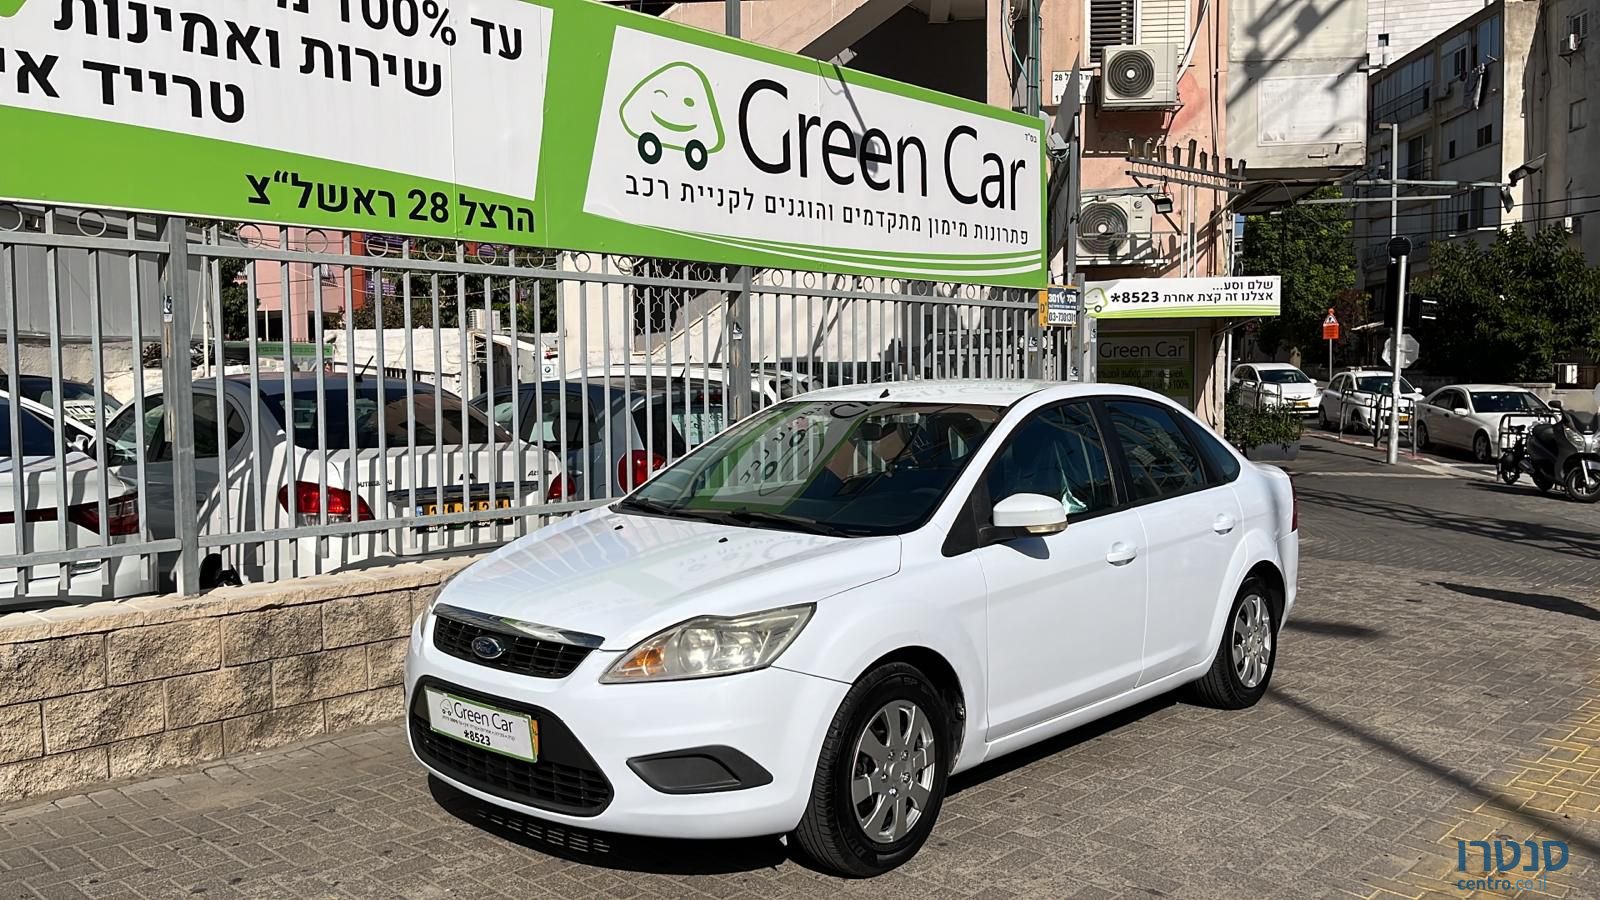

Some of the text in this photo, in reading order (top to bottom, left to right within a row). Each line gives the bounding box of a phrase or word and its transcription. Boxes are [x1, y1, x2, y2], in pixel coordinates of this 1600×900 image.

[54, 0, 442, 97] שירות ואמינות
[471, 17, 522, 60] עד
[82, 59, 245, 124] טרייד
[738, 78, 1026, 211] Green Car
[407, 188, 449, 223] 28
[459, 192, 535, 233] הרצל
[625, 174, 1028, 245] פתרונות מימון מתקדמים והוגנים לקניית רכב
[1162, 293, 1194, 303] אחרת
[1197, 293, 1222, 304] קצת
[1225, 292, 1238, 302] זה
[1241, 290, 1273, 301] אצלנו
[1247, 279, 1274, 290] שלם
[1099, 341, 1185, 359] Green Car
[453, 701, 491, 727] Green
[491, 712, 514, 733] Car
